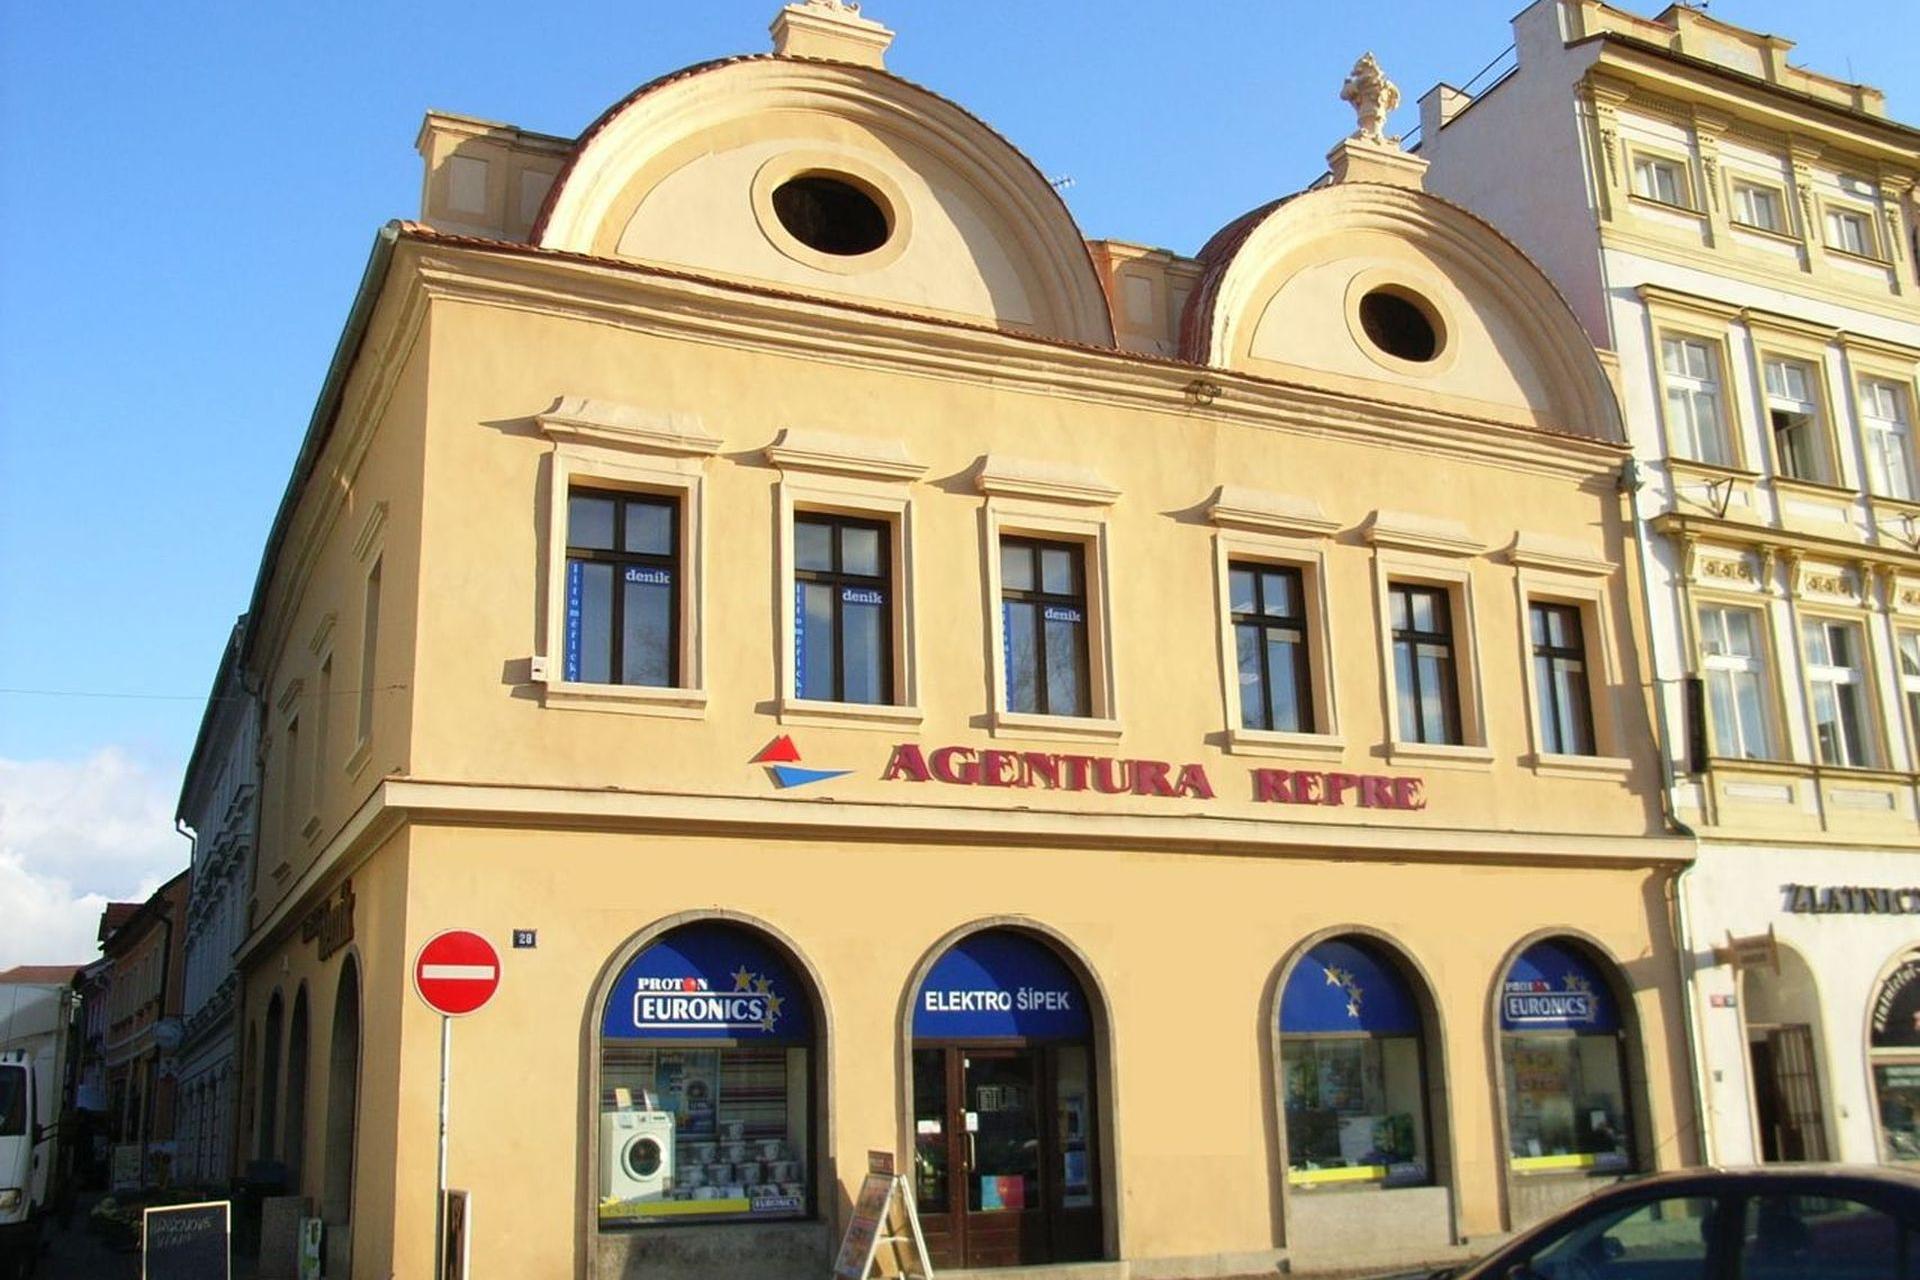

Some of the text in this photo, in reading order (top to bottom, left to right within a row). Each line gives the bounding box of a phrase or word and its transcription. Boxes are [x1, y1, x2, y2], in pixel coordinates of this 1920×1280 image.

[879, 744, 1426, 811] AGENTURA REPRE
[641, 997, 763, 1021] EURONICS
[925, 987, 1070, 1011] ELEKTRO ŠÍPEK
[1509, 997, 1587, 1016] EURONICS
